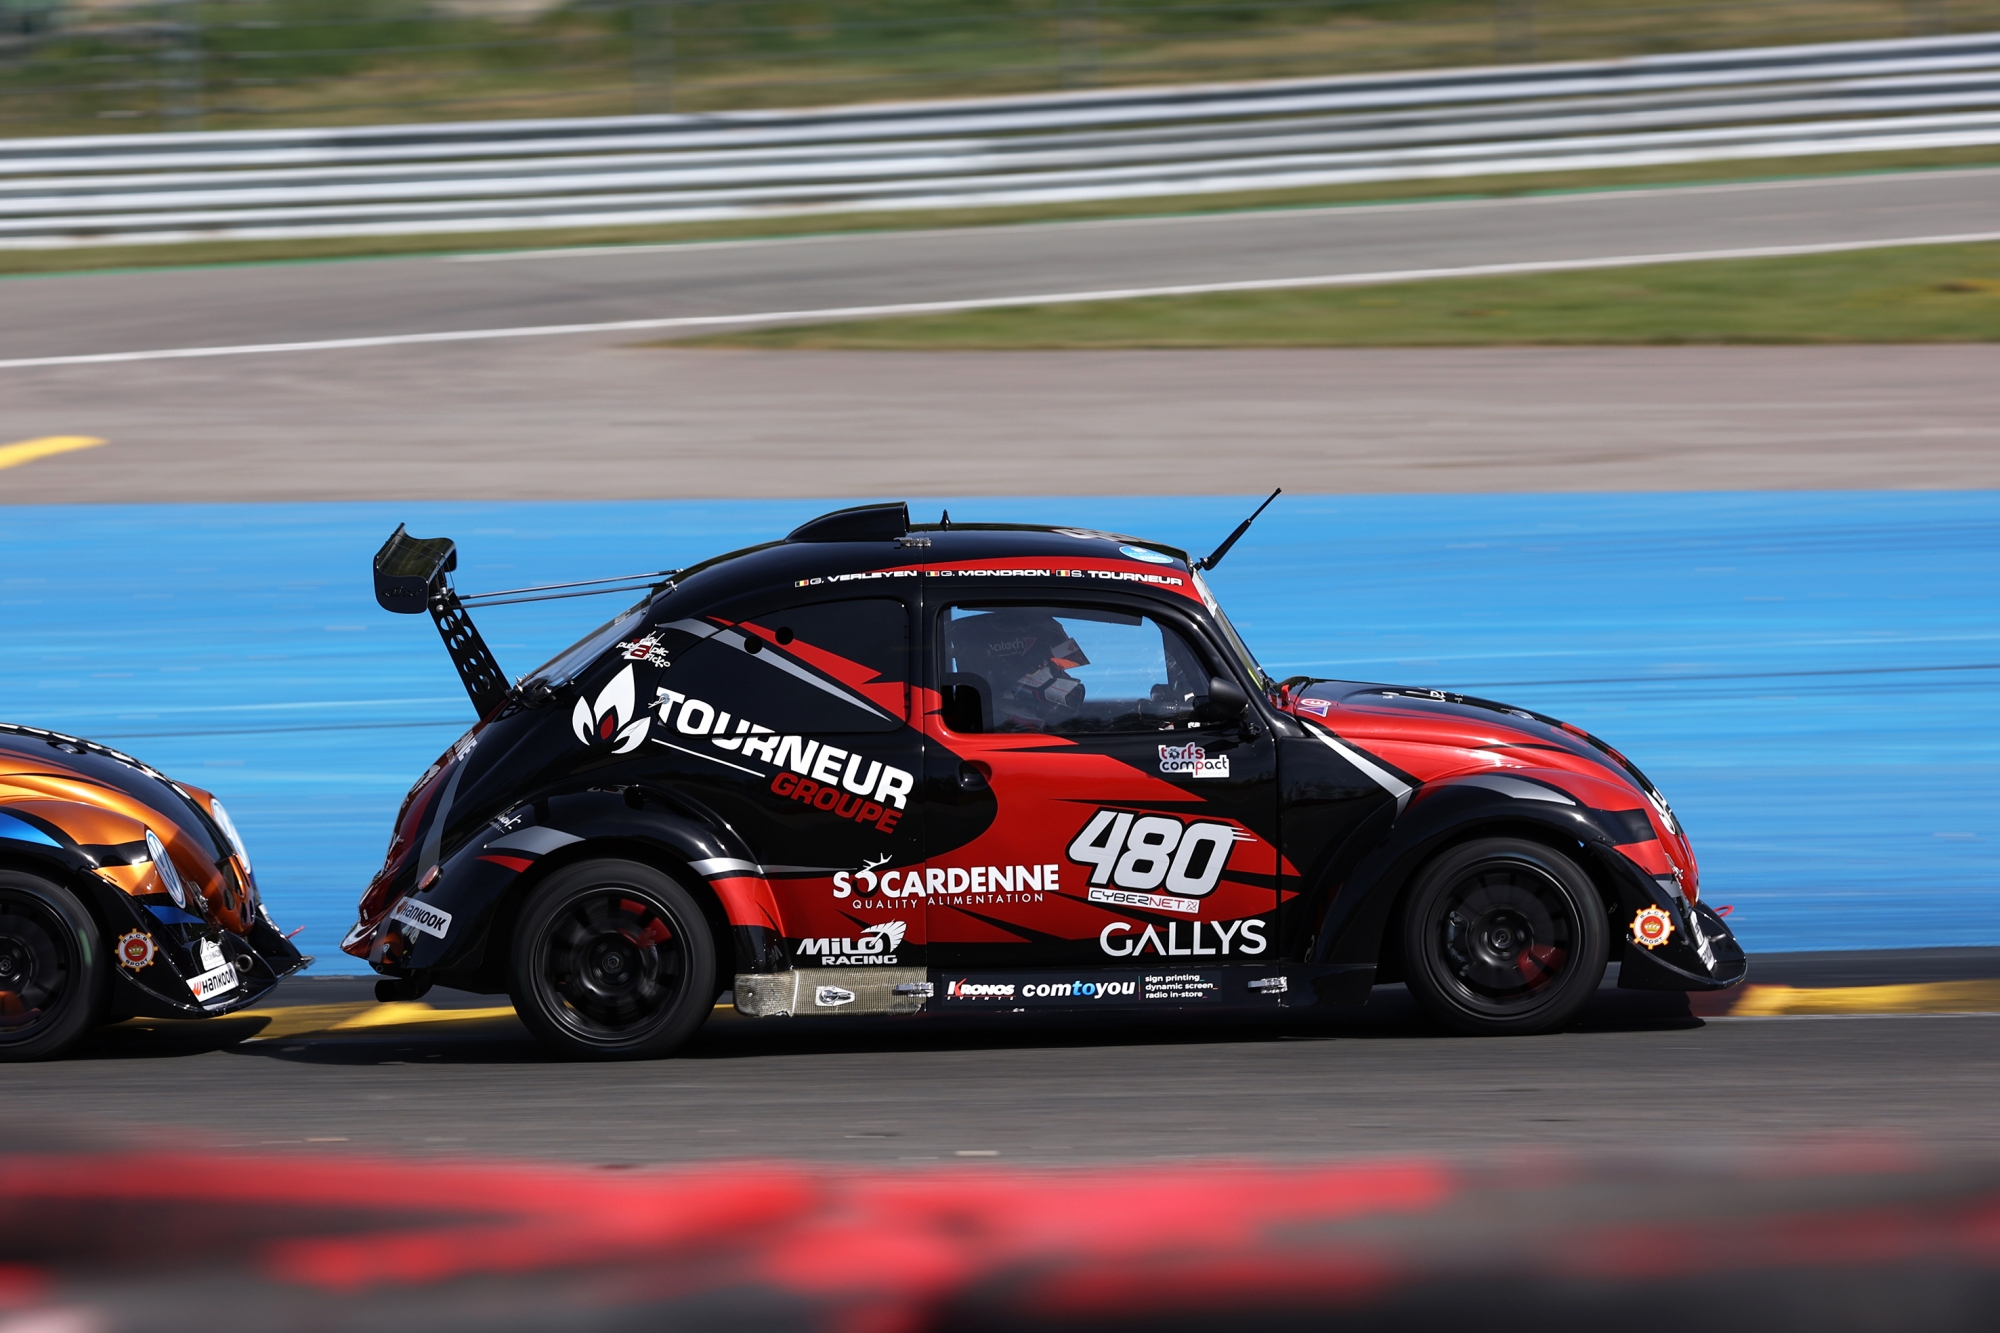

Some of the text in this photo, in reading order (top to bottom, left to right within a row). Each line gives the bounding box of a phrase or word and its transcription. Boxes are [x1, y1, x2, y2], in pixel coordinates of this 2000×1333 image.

[827, 570, 917, 583] VERLEYEN
[958, 569, 1051, 577] MONDRON
[1088, 570, 1183, 586] TOURNEUR
[656, 686, 915, 810] TOURNEUR
[1161, 756, 1228, 776] compact
[770, 772, 904, 834] GROUPE
[1068, 810, 1236, 896] 480
[832, 862, 1060, 899] SOCARDENNE
[852, 892, 1044, 910] QUALITY ALIMENTATION
[1099, 918, 1268, 957] GALLYS
[1639, 935, 1661, 944] SPORT
[125, 958, 150, 967] SPORT
[821, 954, 898, 966] RACING
[1144, 975, 1163, 983] sign
[1144, 982, 1182, 992] dynamic
[1021, 979, 1136, 1000] comtoyou
[1144, 991, 1168, 999] radio
